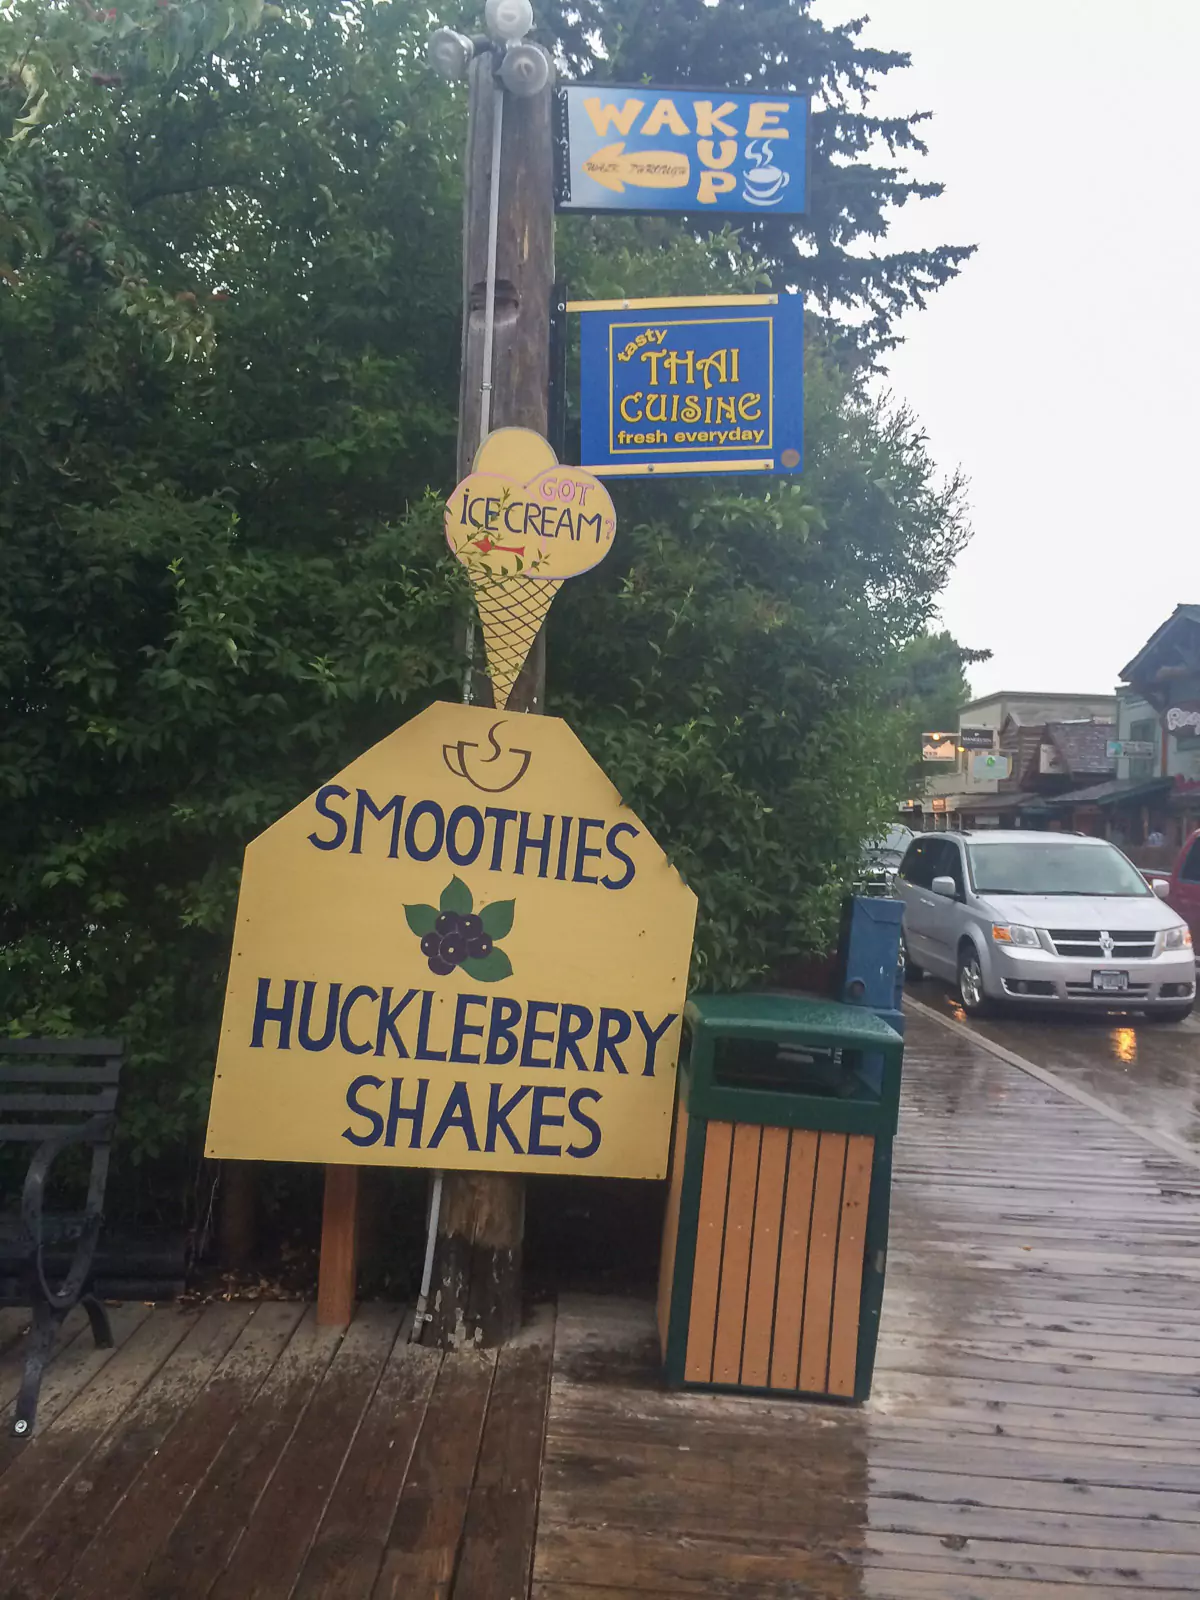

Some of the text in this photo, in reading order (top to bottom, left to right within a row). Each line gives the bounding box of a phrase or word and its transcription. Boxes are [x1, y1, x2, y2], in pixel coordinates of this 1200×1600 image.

[583, 97, 790, 139] WAKE
[696, 139, 738, 204] UP
[617, 328, 667, 363] tasty
[640, 348, 740, 390] THAI
[620, 391, 762, 424] CUISINE
[617, 426, 765, 445] fresh everyday
[539, 477, 595, 506] GOT
[307, 785, 641, 890] SMOOTHIES
[249, 977, 679, 1077] HUCKLEBERRY
[341, 1075, 604, 1159] SHAKES
